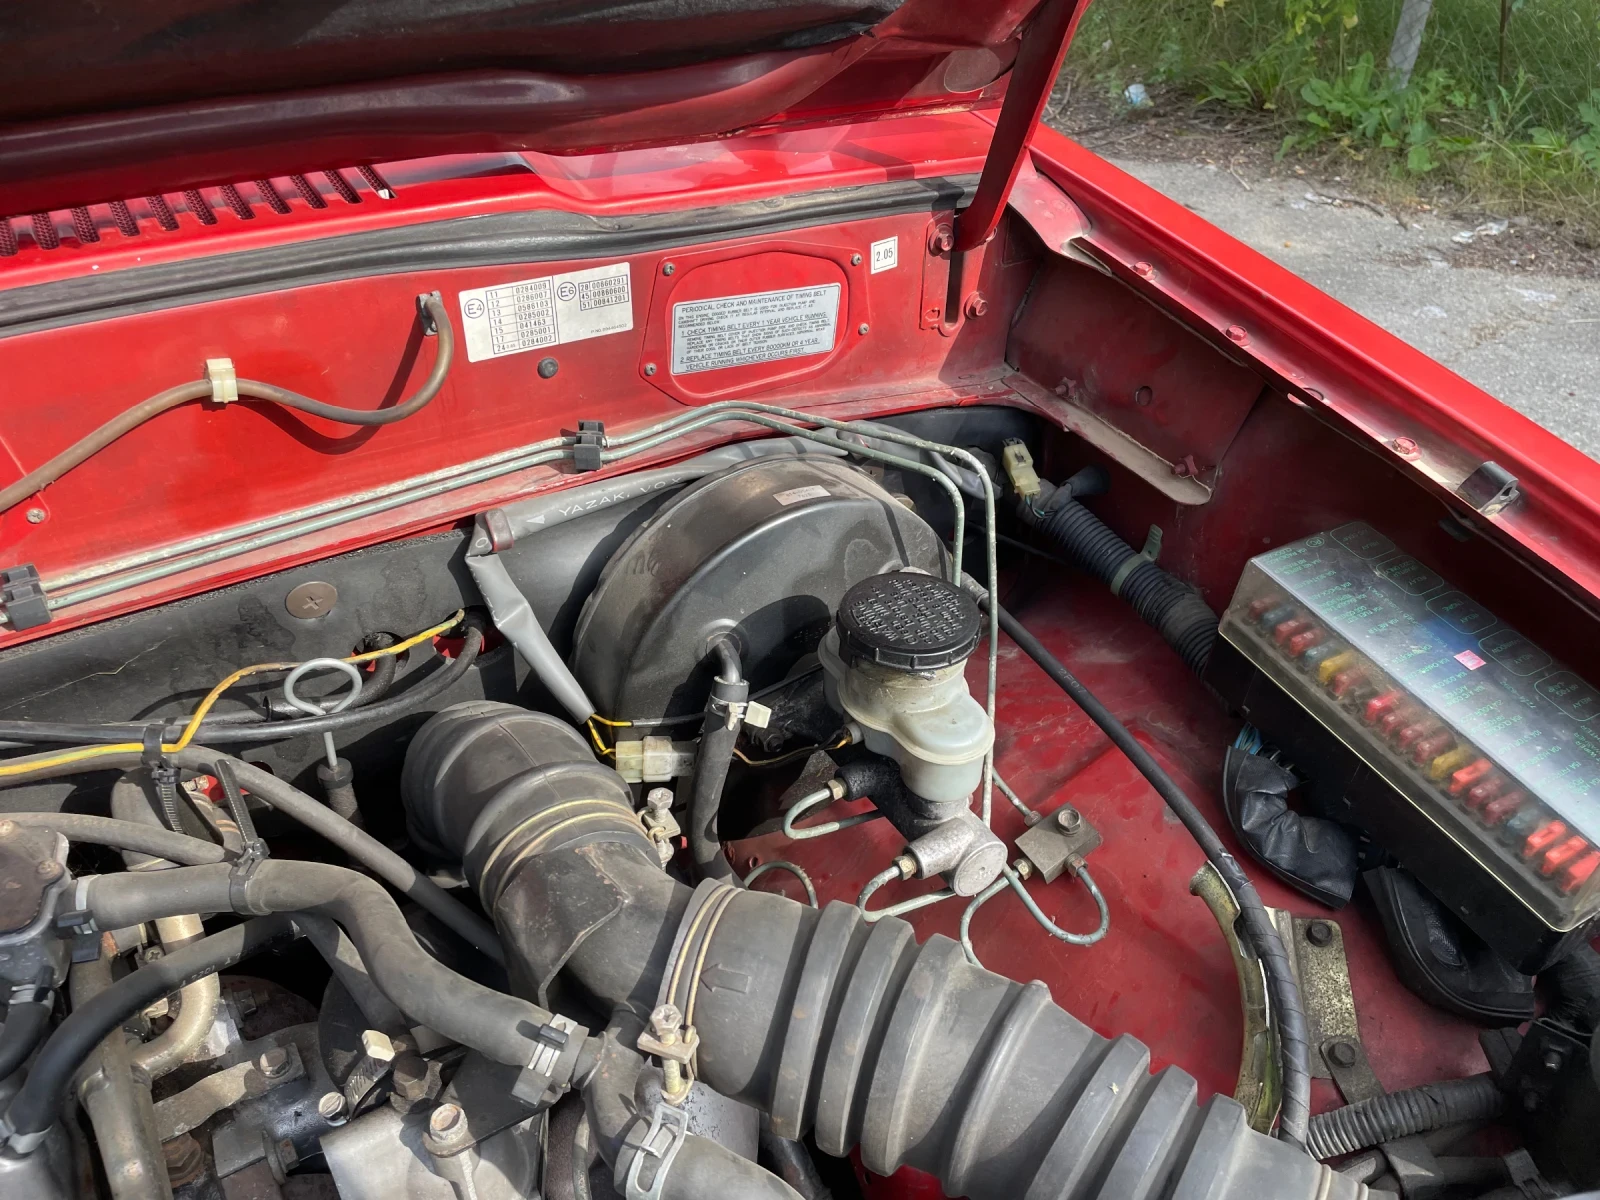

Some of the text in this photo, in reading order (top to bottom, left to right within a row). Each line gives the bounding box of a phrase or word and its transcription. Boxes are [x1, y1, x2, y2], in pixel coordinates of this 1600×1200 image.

[876, 247, 893, 262] 2.05
[560, 285, 574, 297] E6
[581, 292, 589, 300] 45
[716, 301, 735, 309] CHECK
[736, 299, 747, 307] AND
[748, 294, 785, 305] MAINTENANCE
[795, 291, 812, 299] TIMING
[813, 289, 826, 297] BELT
[466, 302, 482, 315] E4
[493, 317, 502, 325] 14
[686, 327, 705, 335] CHECK
[707, 325, 725, 333] TIMING
[742, 320, 760, 328] EVERY
[781, 314, 803, 322] VEHICLE
[494, 326, 503, 334] 15
[495, 335, 504, 343] 17
[496, 344, 505, 352] 24
[686, 352, 712, 361] REPLACE
[733, 347, 746, 355] BELT
[747, 345, 765, 353] EVERY
[685, 361, 709, 369] VEHICLE
[710, 357, 734, 366] RUNNING
[735, 353, 765, 362] WHICHEVER
[767, 349, 788, 358] OCCURS
[883, 599, 914, 626] before
[853, 600, 899, 641] WARNING
[889, 620, 918, 644] Clean
